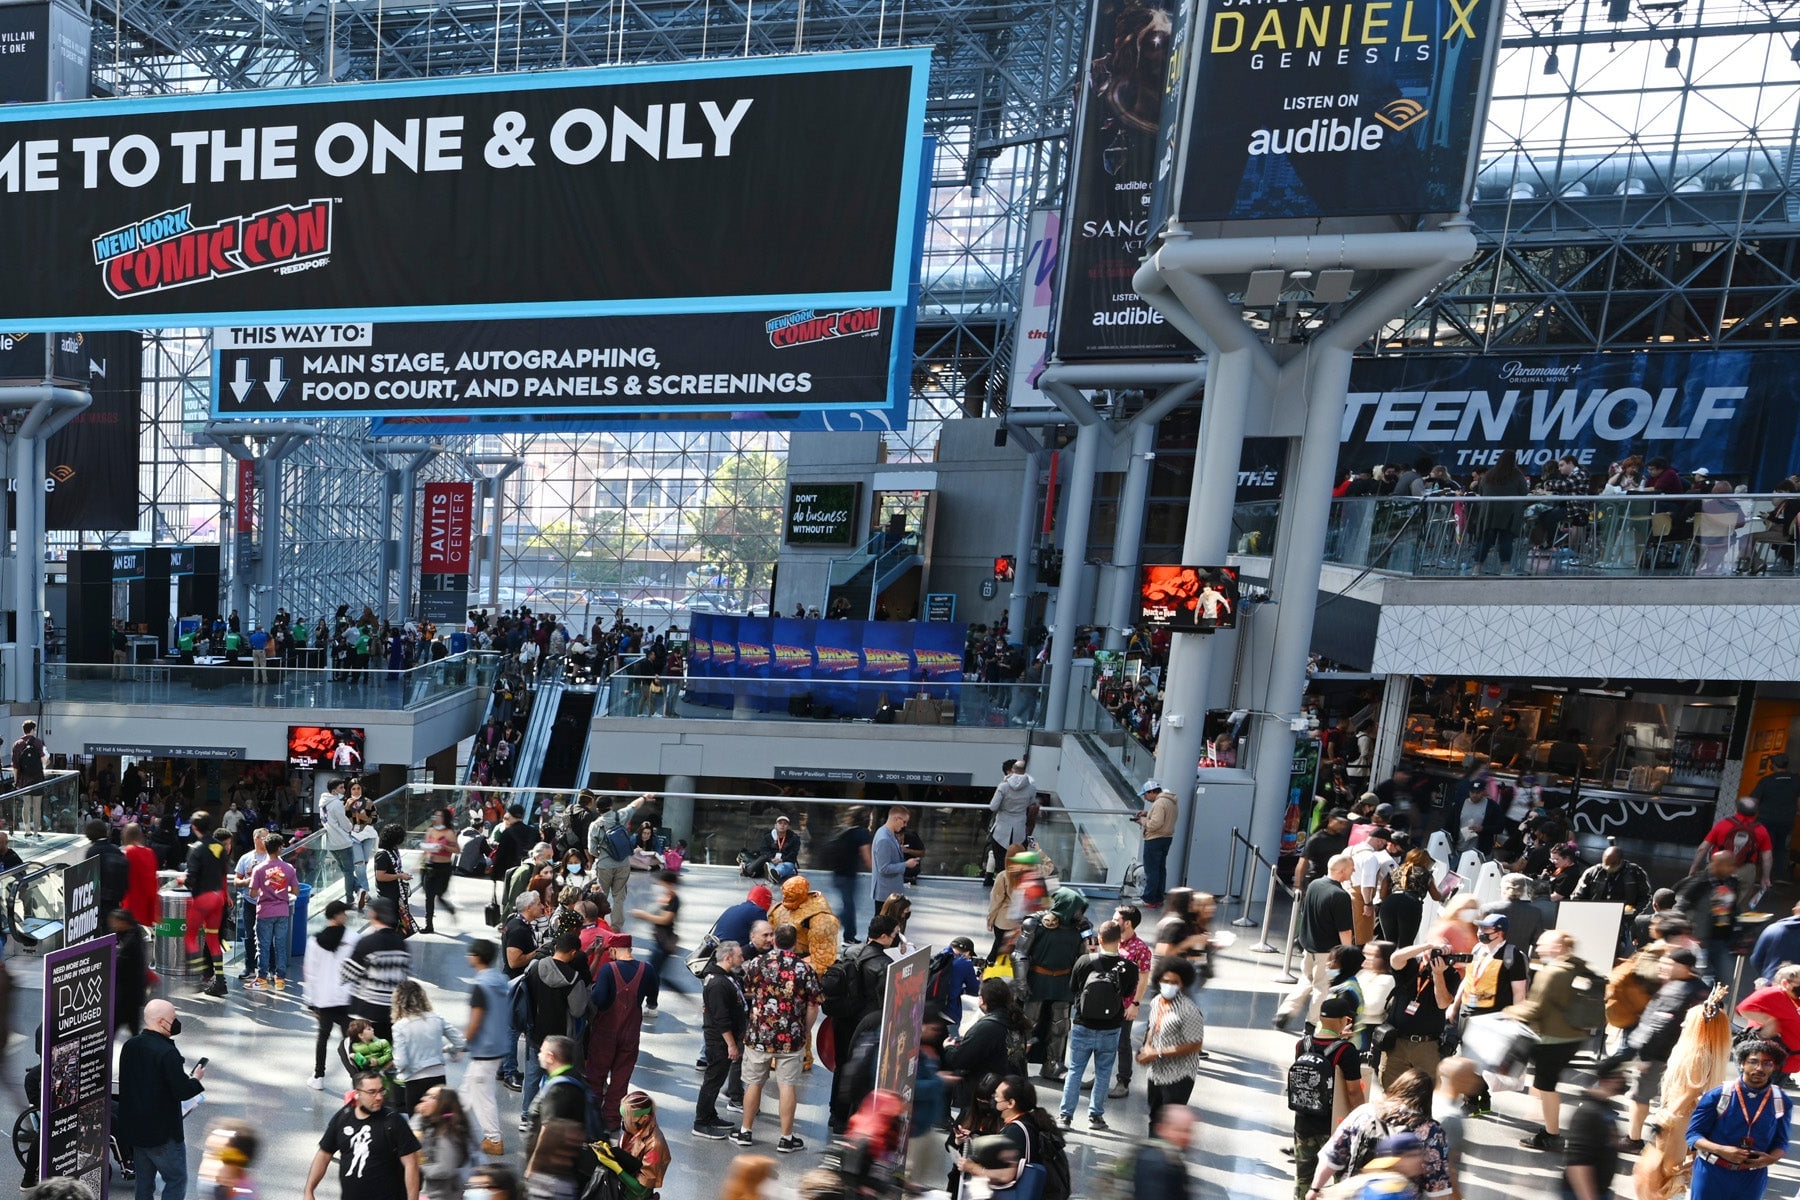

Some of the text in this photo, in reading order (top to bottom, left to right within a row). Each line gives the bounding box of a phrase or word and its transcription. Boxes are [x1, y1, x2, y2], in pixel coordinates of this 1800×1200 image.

[2, 31, 36, 42] VILLAIN
[1211, 0, 1478, 53] DANIEL X
[10, 44, 26, 54] ONE
[1250, 45, 1430, 70] GENESIS
[1284, 94, 1359, 110] LISTEN ON
[72, 134, 160, 189] TO
[170, 124, 298, 184] THE
[314, 115, 464, 178] ONE
[483, 110, 536, 168] &
[549, 98, 754, 166] ONLY
[1248, 118, 1383, 156] audible
[1114, 181, 1147, 191] audible
[96, 210, 189, 260] NEW YORK
[110, 205, 326, 292] COMIC CON
[1112, 294, 1139, 302] LISTEN
[768, 309, 814, 332] NEW YORK
[772, 308, 878, 345] COMIC CON
[1092, 306, 1164, 326] audible
[231, 325, 365, 344] THIS WAY TO:
[303, 347, 661, 375] MAIN STAGE, AUTOGRAPHING,
[1498, 360, 1582, 380] Paramount+
[302, 372, 812, 402] FOOD COURT, AND PANELS & SCREENINGS
[1339, 387, 1748, 442] TEEN WOLF
[793, 504, 847, 522] do business
[430, 494, 464, 562] JAVITS CENTER
[124, 555, 136, 569] EXIT
[434, 574, 455, 591] 1E
[72, 881, 94, 913] NYCC
[68, 906, 98, 943] GAMING
[52, 962, 102, 985] ROLLING YOUR LIFE?
[53, 957, 90, 976] NEED MORE DICE
[59, 975, 102, 1017] PAX
[58, 1007, 101, 1031] UNPLUGGED
